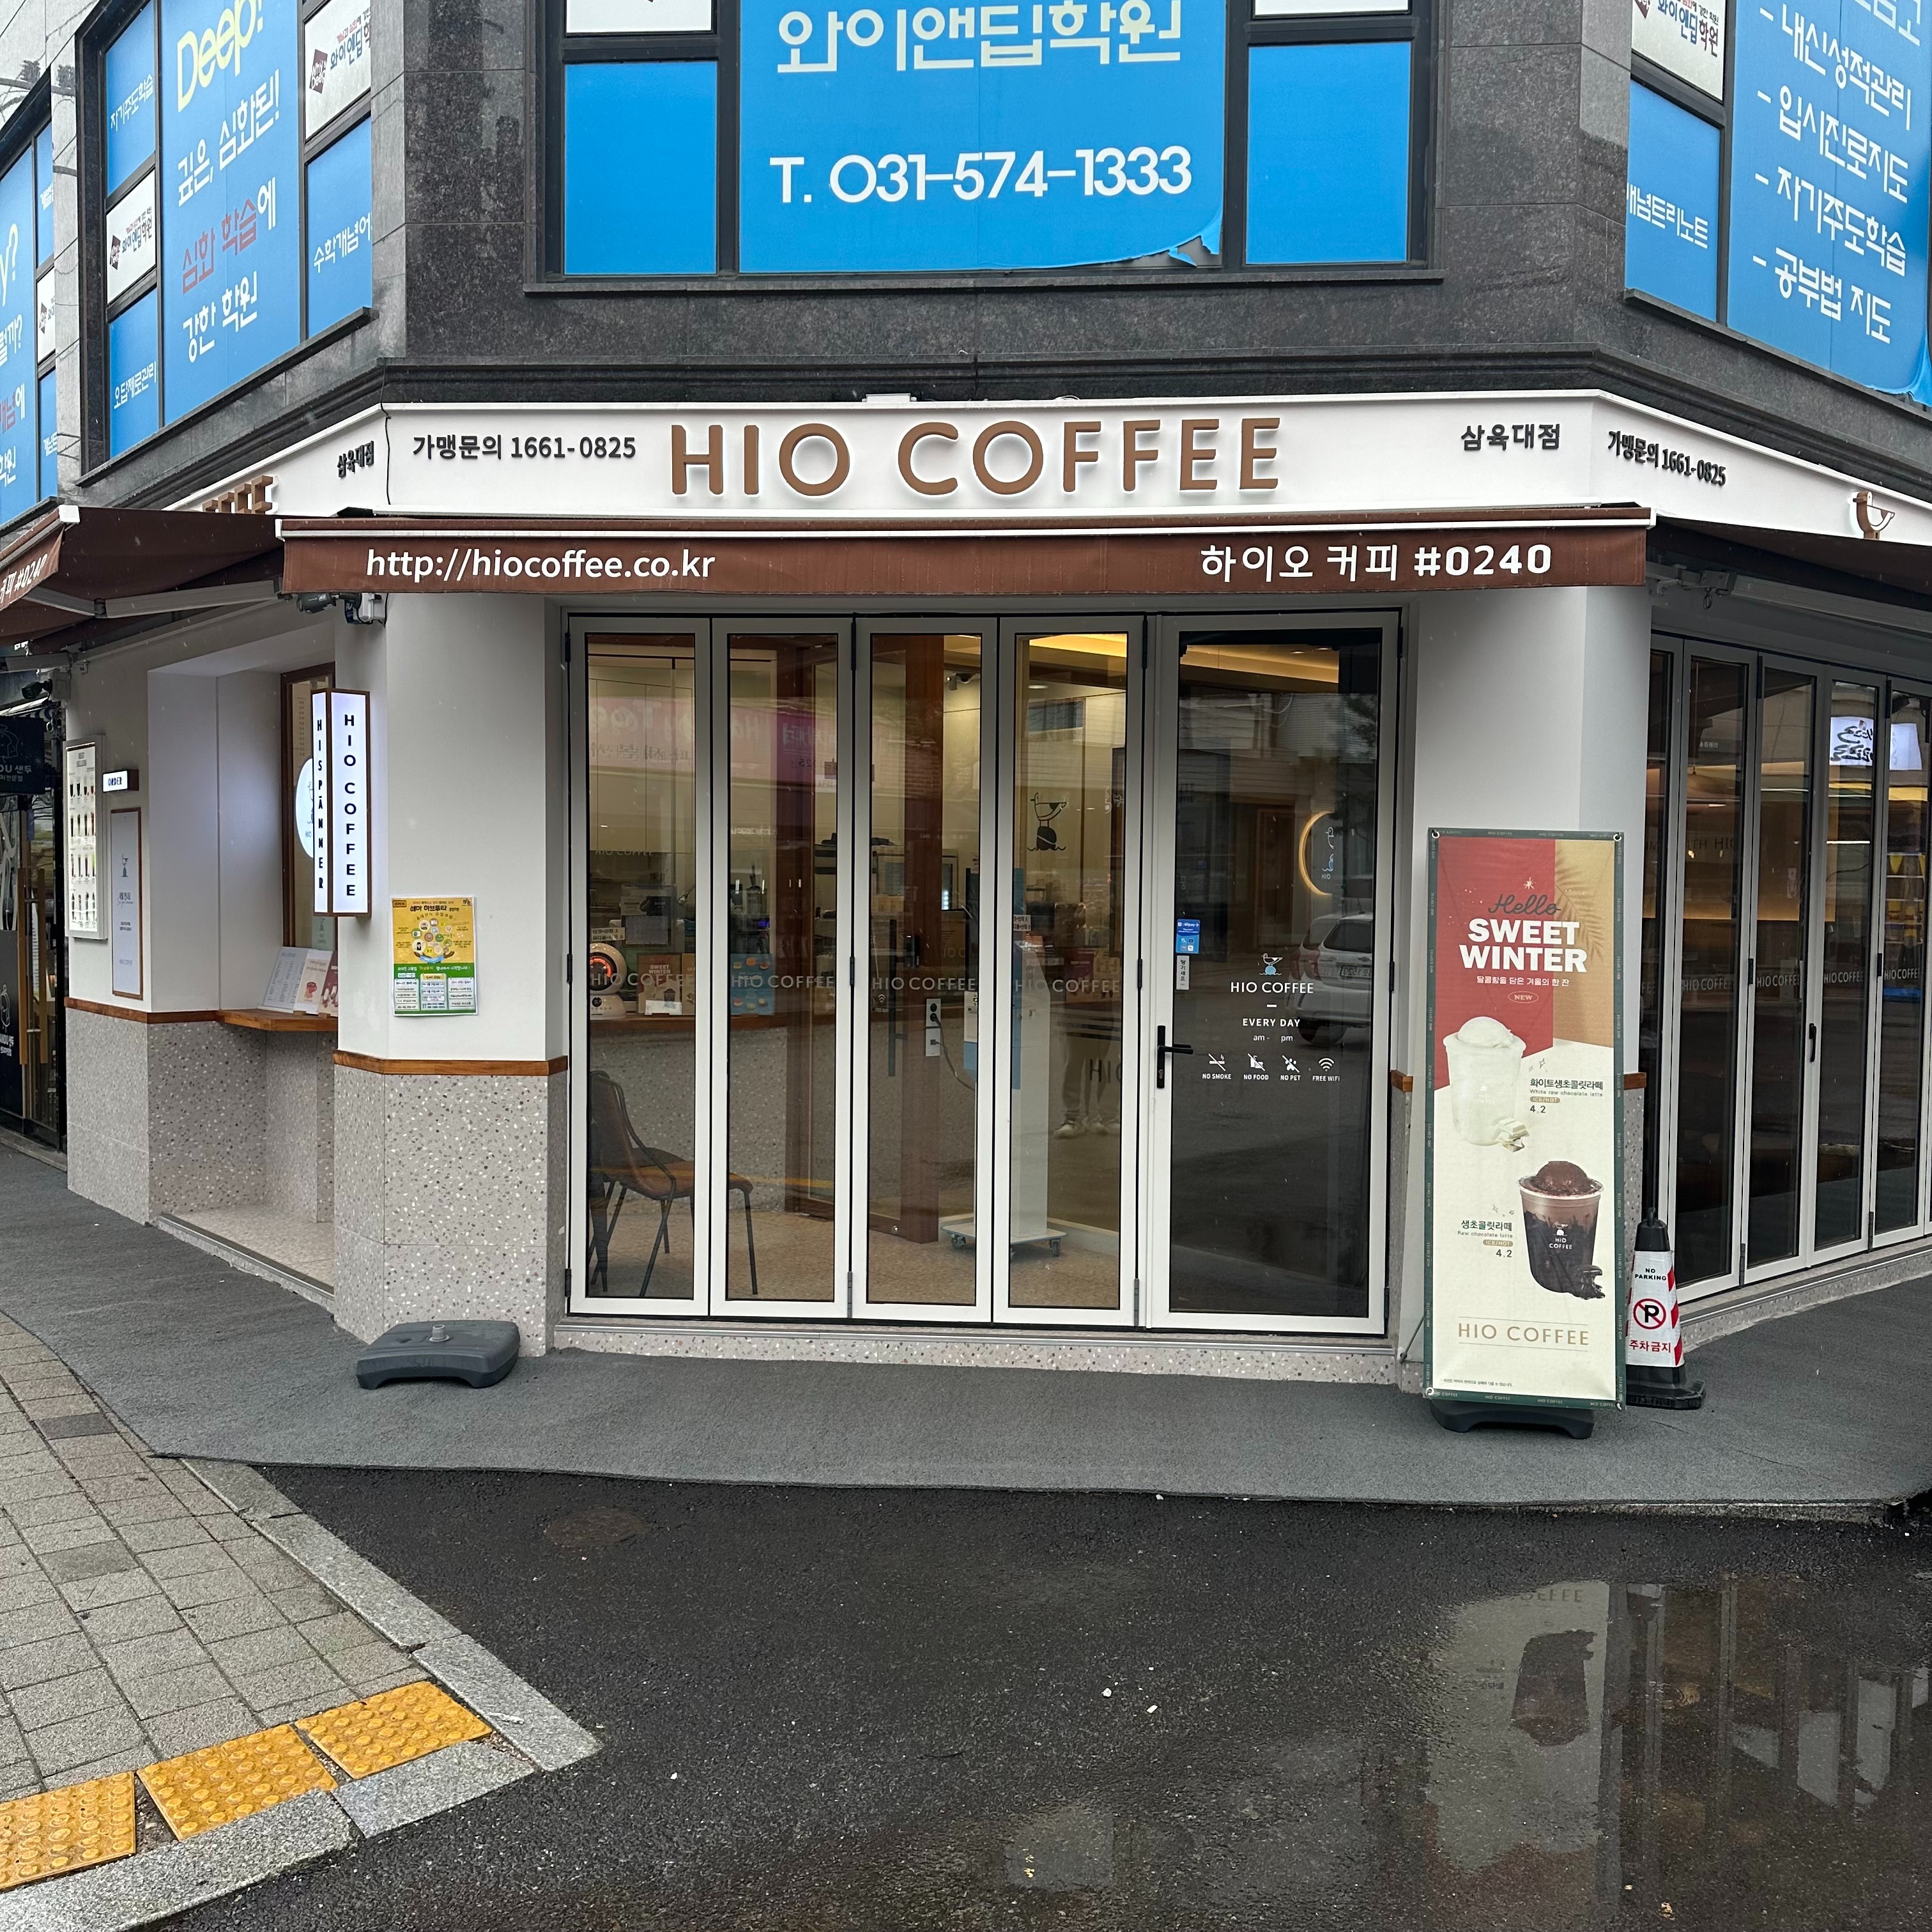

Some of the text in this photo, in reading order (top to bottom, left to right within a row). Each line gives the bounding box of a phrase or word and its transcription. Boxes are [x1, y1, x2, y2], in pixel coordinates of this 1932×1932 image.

[1781, 4, 1912, 131] 내신성적관리
[109, 73, 154, 132] 자기주도학습
[178, 68, 280, 207] 깊은, 심화된!
[1779, 85, 1908, 204] 입시진로지도
[770, 145, 1192, 203] T. 031-574-1333
[181, 177, 276, 295] 심화 학습에
[1777, 166, 1906, 277] 자기주도학습
[1775, 247, 1891, 344] 공부법 지도
[183, 271, 259, 363] 강한 학원
[114, 360, 157, 410] 오답제로관리
[413, 434, 636, 460] 가맹문의 1661-0825
[1460, 423, 1561, 450] 삼육대점
[337, 440, 375, 478] 삼육대점
[671, 417, 1281, 498] HIO COFFEE
[1607, 430, 1727, 486] 가맹문의 1661-0825
[367, 548, 716, 583] http://hiocoffee.co.kr
[1201, 544, 1552, 583] 하이오 커피 #0240
[344, 714, 357, 896] HIO COFFEE
[1488, 894, 1561, 916] Hello
[1468, 918, 1579, 945] SWEET
[1459, 944, 1587, 972] WINTER
[872, 977, 976, 991] HIO COFFEE
[1230, 982, 1314, 993] HIO COFFEE
[1476, 976, 1506, 985] 달콤함을
[1509, 977, 1524, 985] 담은
[1527, 977, 1549, 986] 겨울의
[1552, 978, 1560, 986] 한
[1243, 1018, 1300, 1027] EVERY DAY
[1089, 1059, 1121, 1084] HI
[1458, 1322, 1589, 1346] HIO COFFEE
[1629, 1340, 1671, 1353] 주차금지
